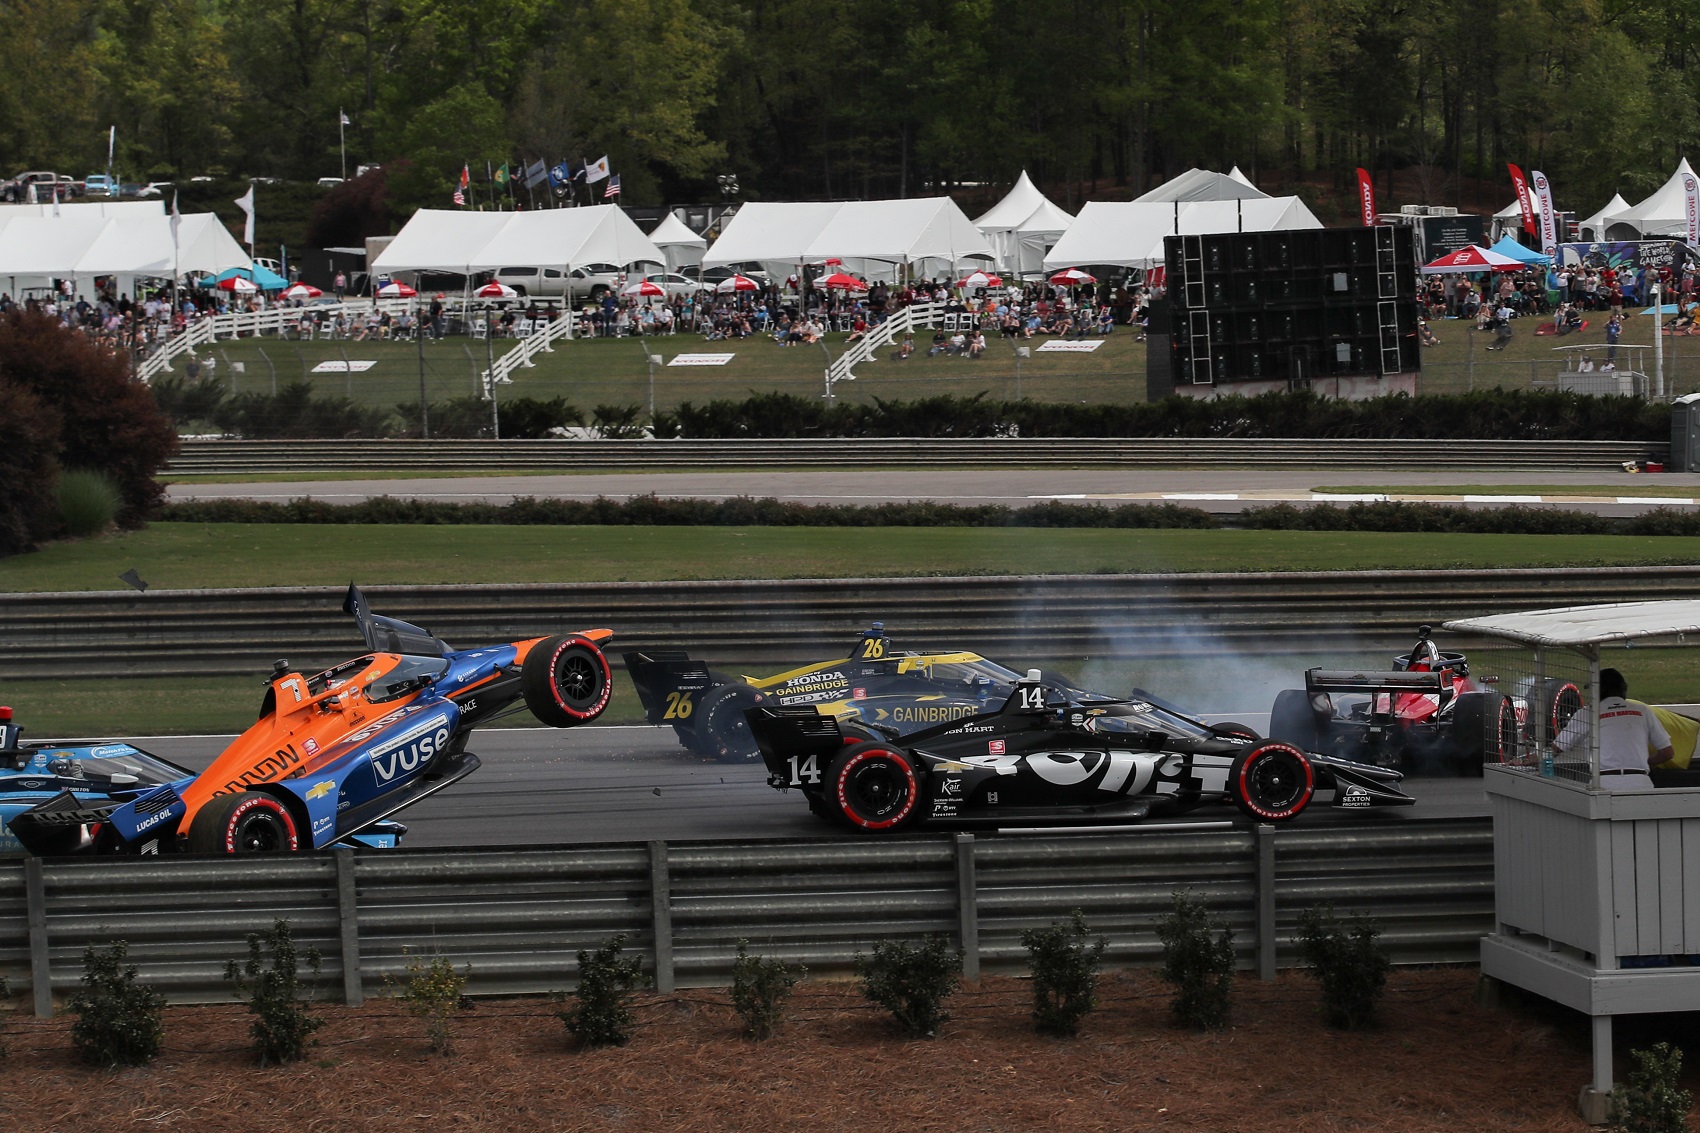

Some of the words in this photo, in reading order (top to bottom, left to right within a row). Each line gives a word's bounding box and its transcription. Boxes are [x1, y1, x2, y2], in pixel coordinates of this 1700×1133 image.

[862, 638, 884, 658] 26
[776, 679, 849, 696] GAINBRIDGE
[786, 671, 846, 687] HONDA
[280, 679, 302, 703] 7
[1019, 687, 1045, 709] 14
[662, 691, 693, 720] 26
[893, 705, 979, 722] GAINBRIDGE
[787, 754, 821, 786] 14
[136, 816, 160, 832] LUCAS
[159, 809, 172, 823] OIL
[227, 797, 259, 852] Firestone
